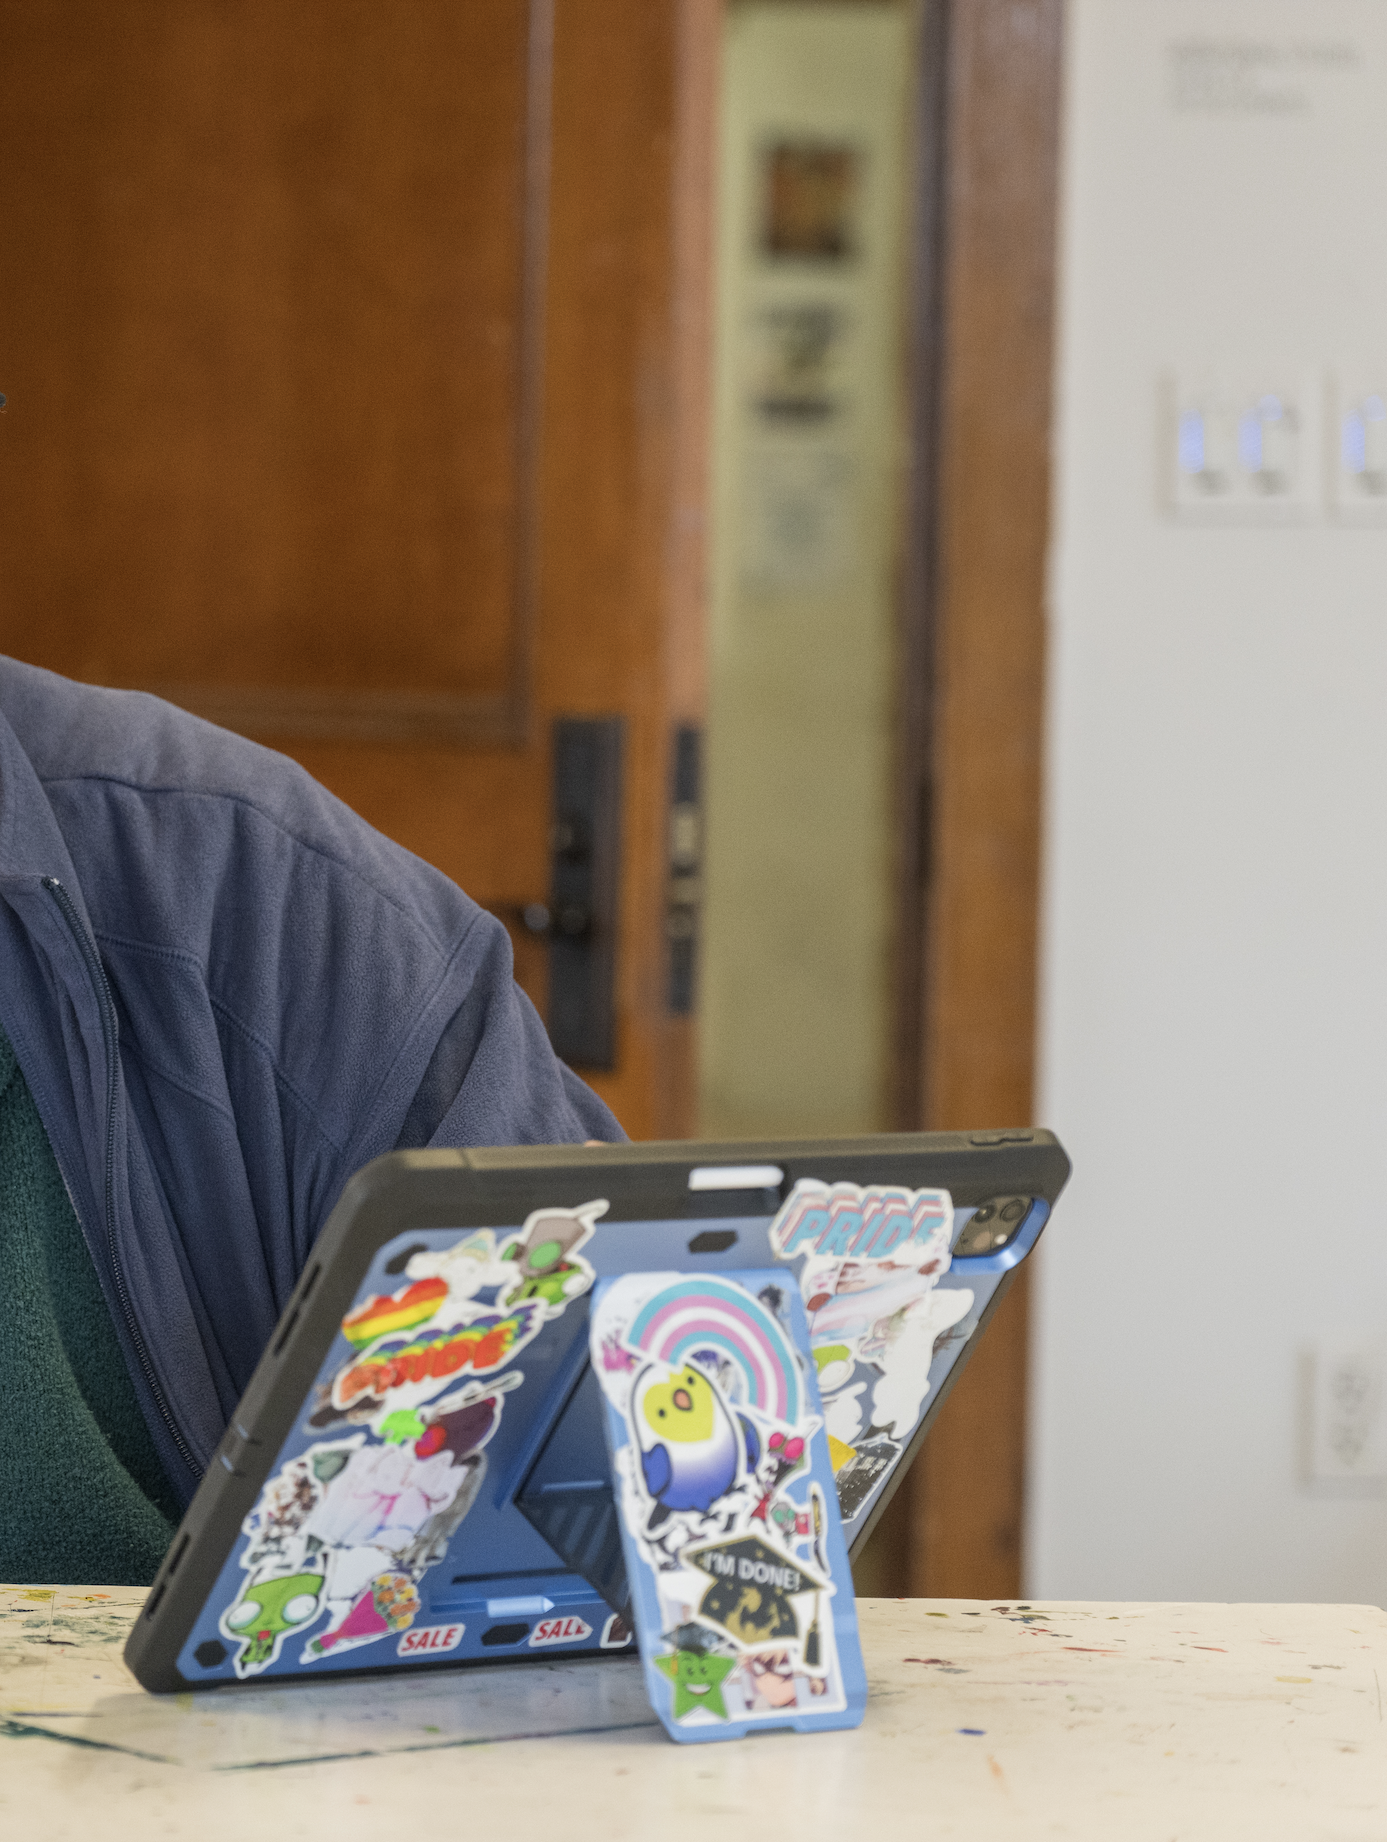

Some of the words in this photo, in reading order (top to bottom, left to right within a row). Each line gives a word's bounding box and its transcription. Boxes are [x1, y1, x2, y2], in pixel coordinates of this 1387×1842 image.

[780, 1200, 945, 1259] PRIDE
[702, 1552, 737, 1577] I'M
[738, 1557, 801, 1592] DONE!
[401, 1627, 459, 1652] SALE
